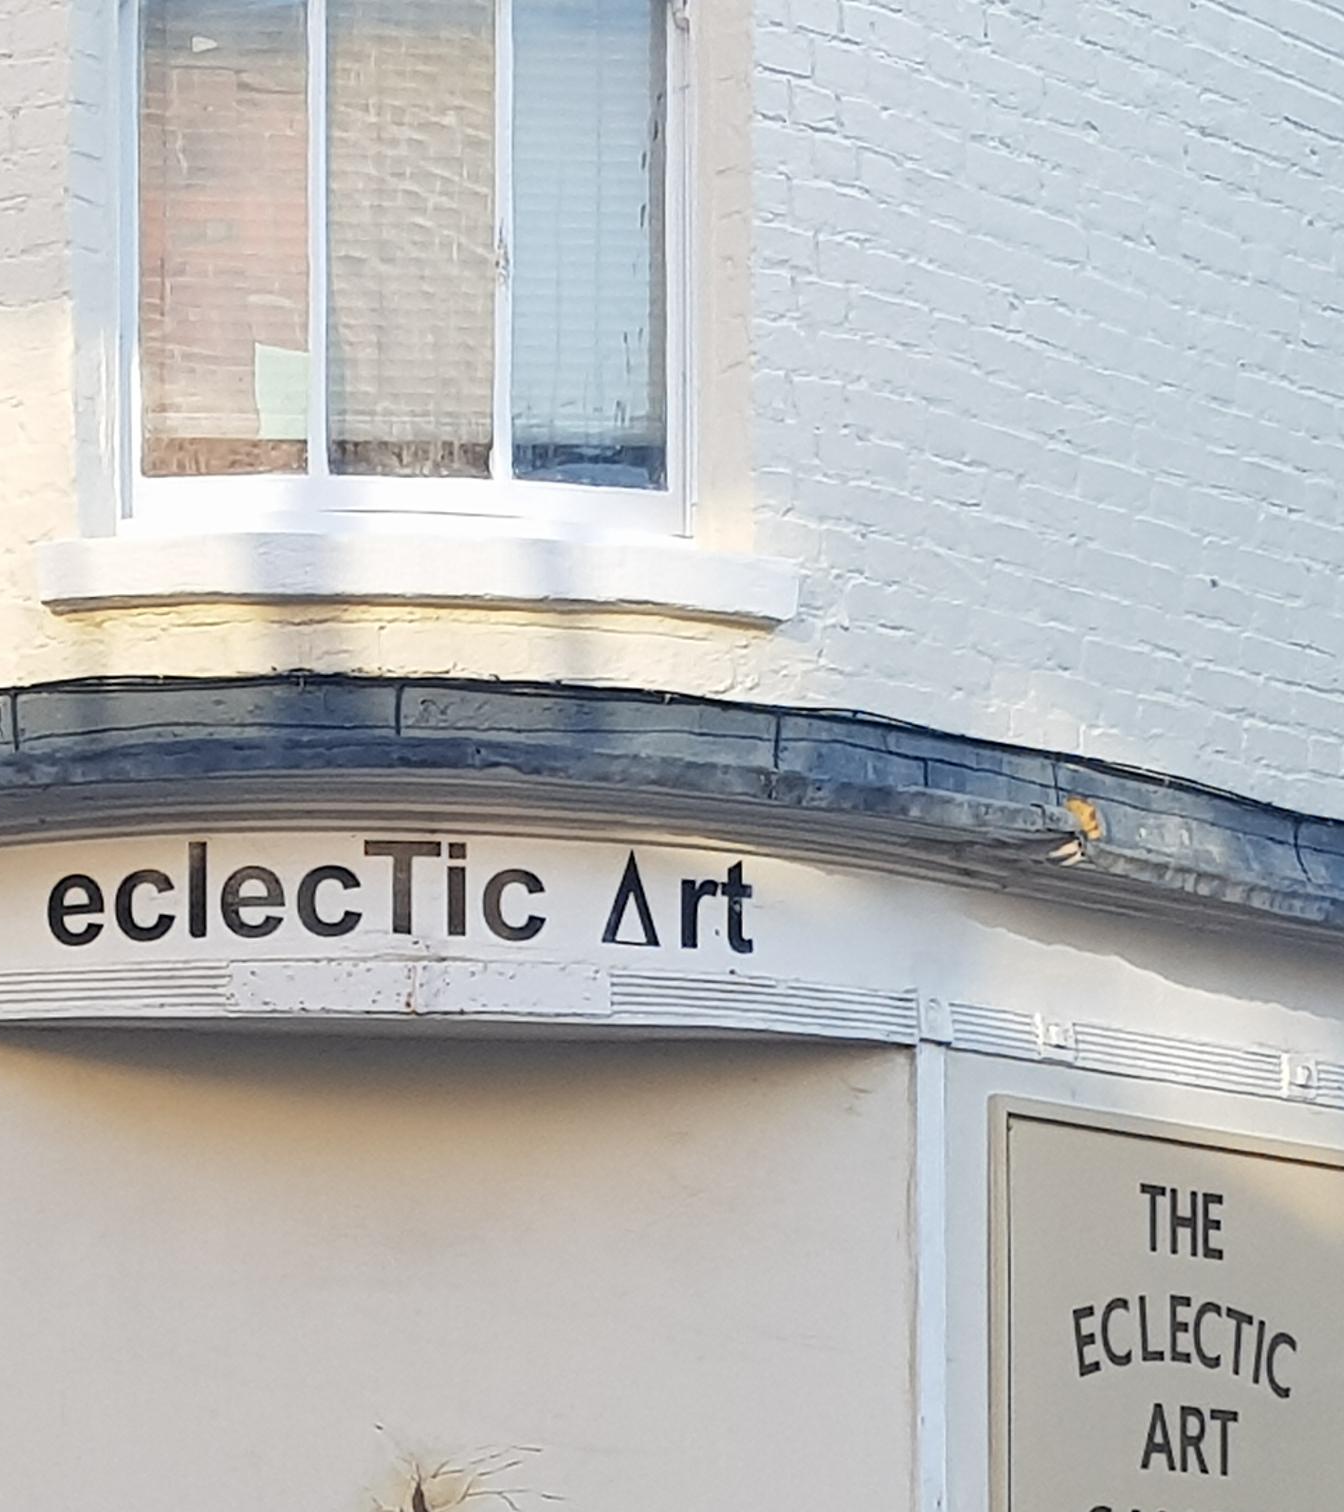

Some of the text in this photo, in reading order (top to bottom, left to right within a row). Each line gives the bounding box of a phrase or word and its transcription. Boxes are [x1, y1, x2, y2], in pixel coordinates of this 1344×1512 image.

[46, 839, 546, 947] eclecTic
[1138, 1181, 1225, 1261] THE
[1071, 1293, 1298, 1400] ECLECTIC
[1139, 1402, 1240, 1478] ART
